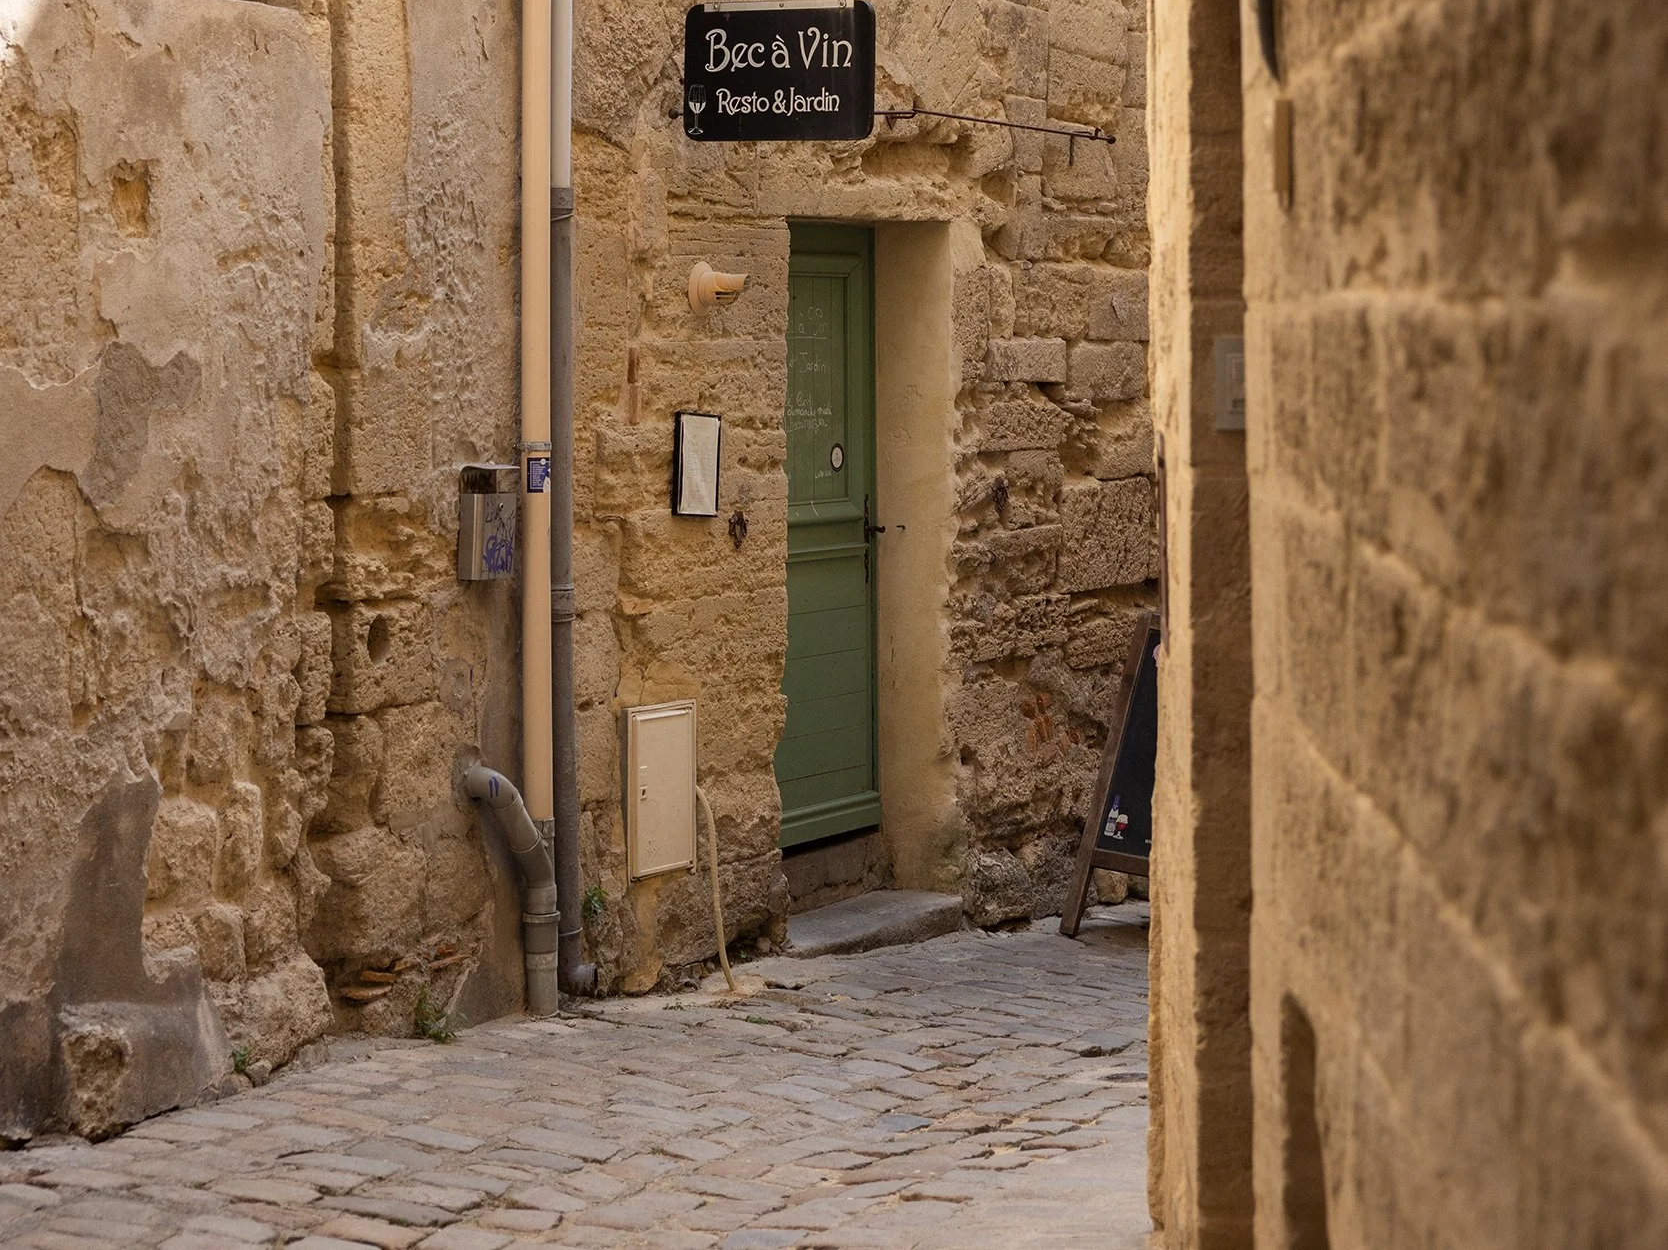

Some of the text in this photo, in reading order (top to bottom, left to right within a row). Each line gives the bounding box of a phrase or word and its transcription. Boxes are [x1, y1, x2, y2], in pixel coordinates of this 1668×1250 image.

[704, 26, 853, 73] Bec à Vin
[715, 88, 770, 116] Resto
